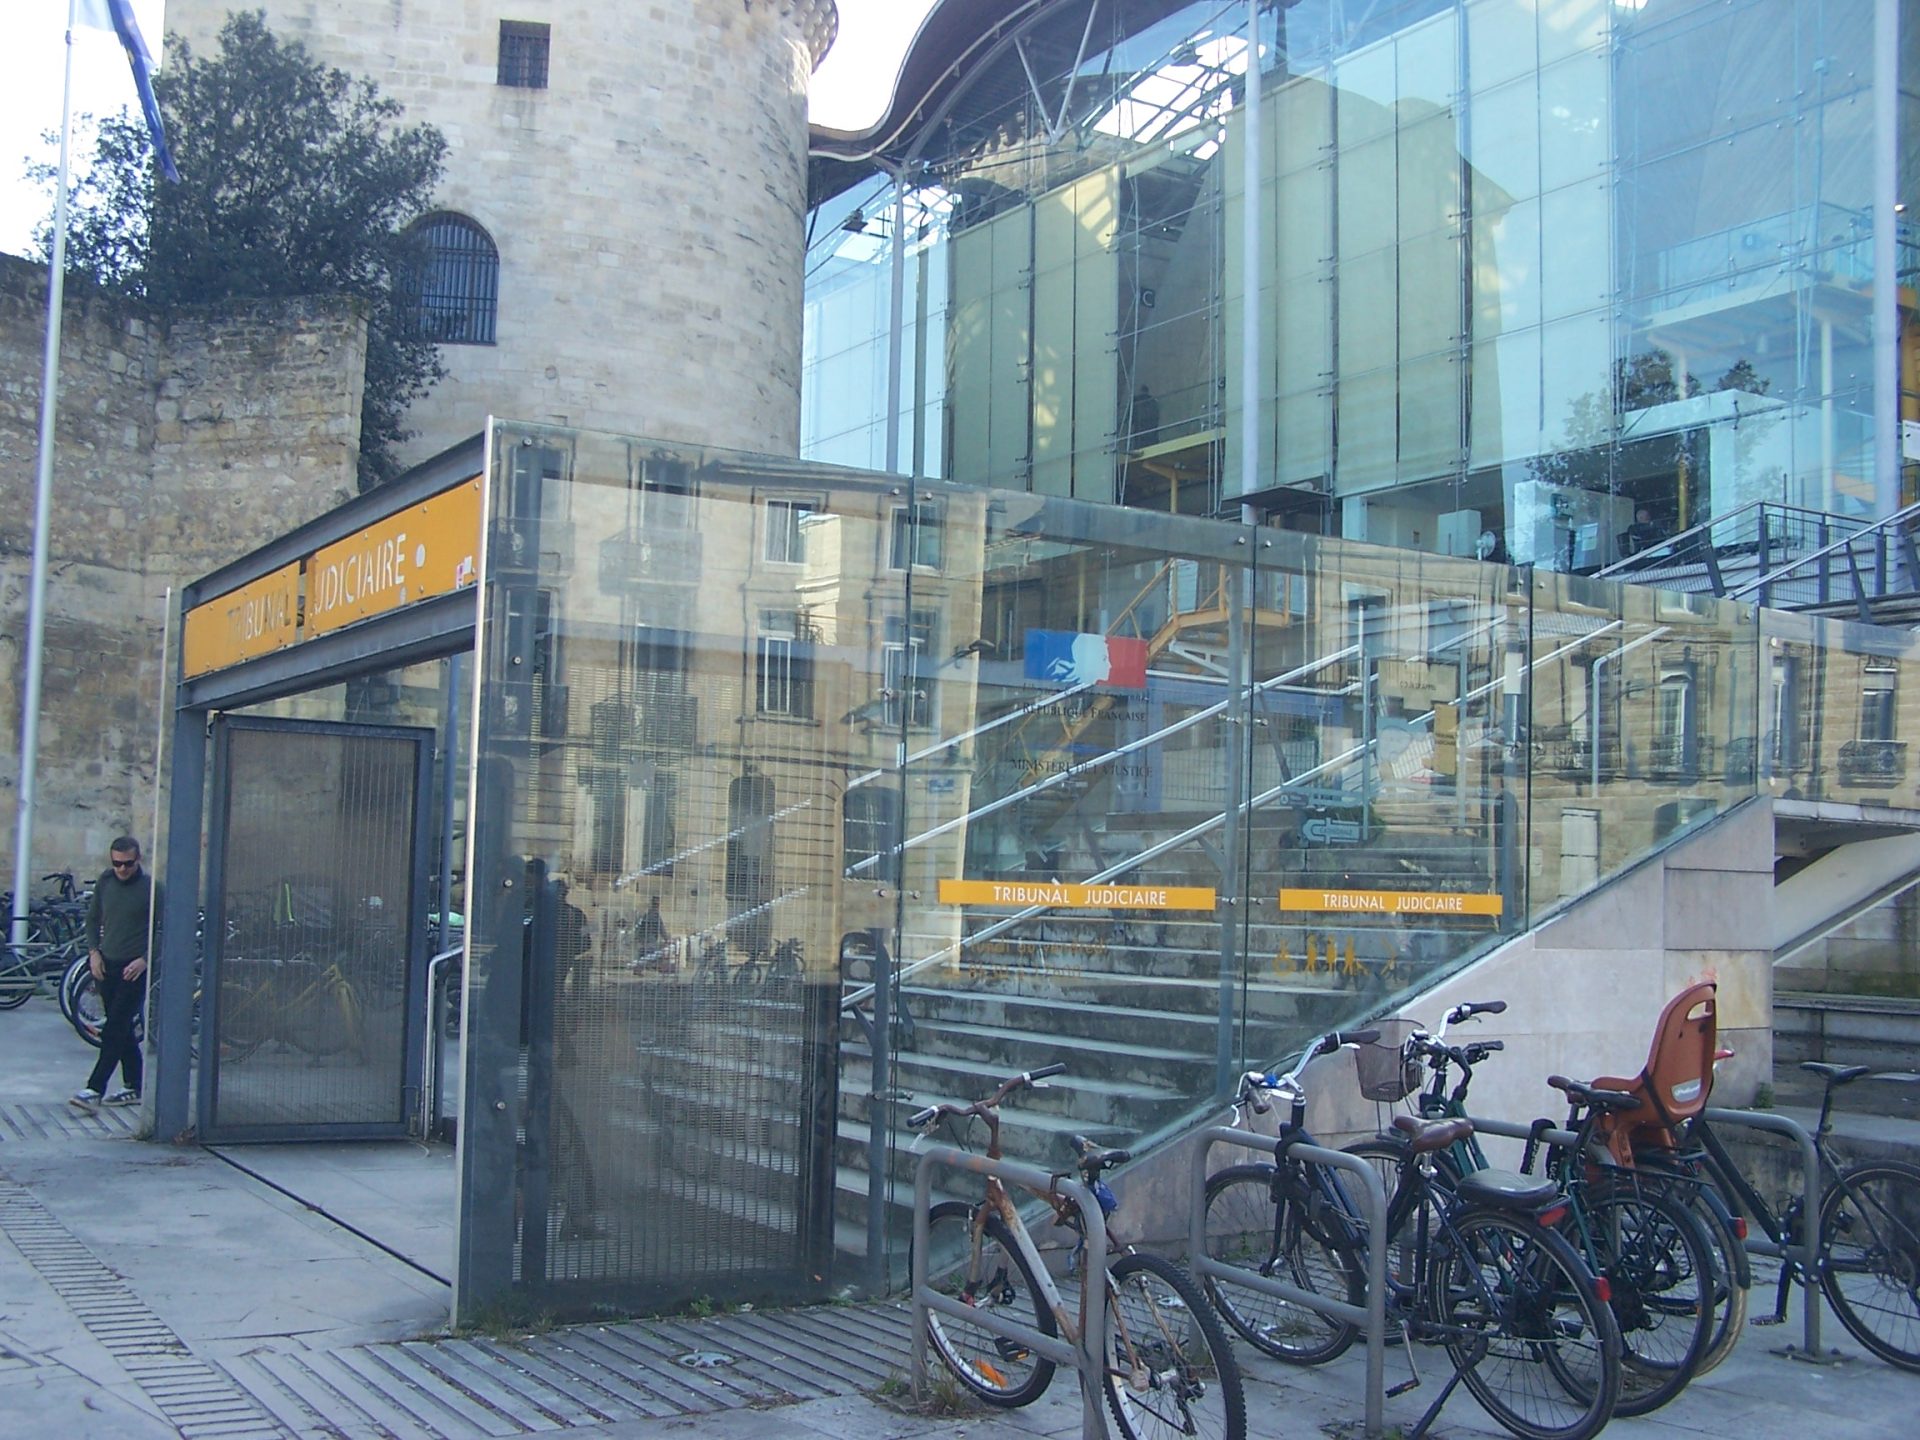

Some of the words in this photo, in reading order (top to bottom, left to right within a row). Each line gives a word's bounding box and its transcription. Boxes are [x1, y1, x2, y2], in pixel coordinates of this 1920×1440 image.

[309, 534, 406, 616] UDICIAIRE
[993, 885, 1070, 904] TRIBUNAL
[1084, 889, 1167, 906] JUDICIAIRE
[1323, 894, 1385, 910] TRIBUNAL
[1396, 897, 1463, 912] JUDICIAIRE
